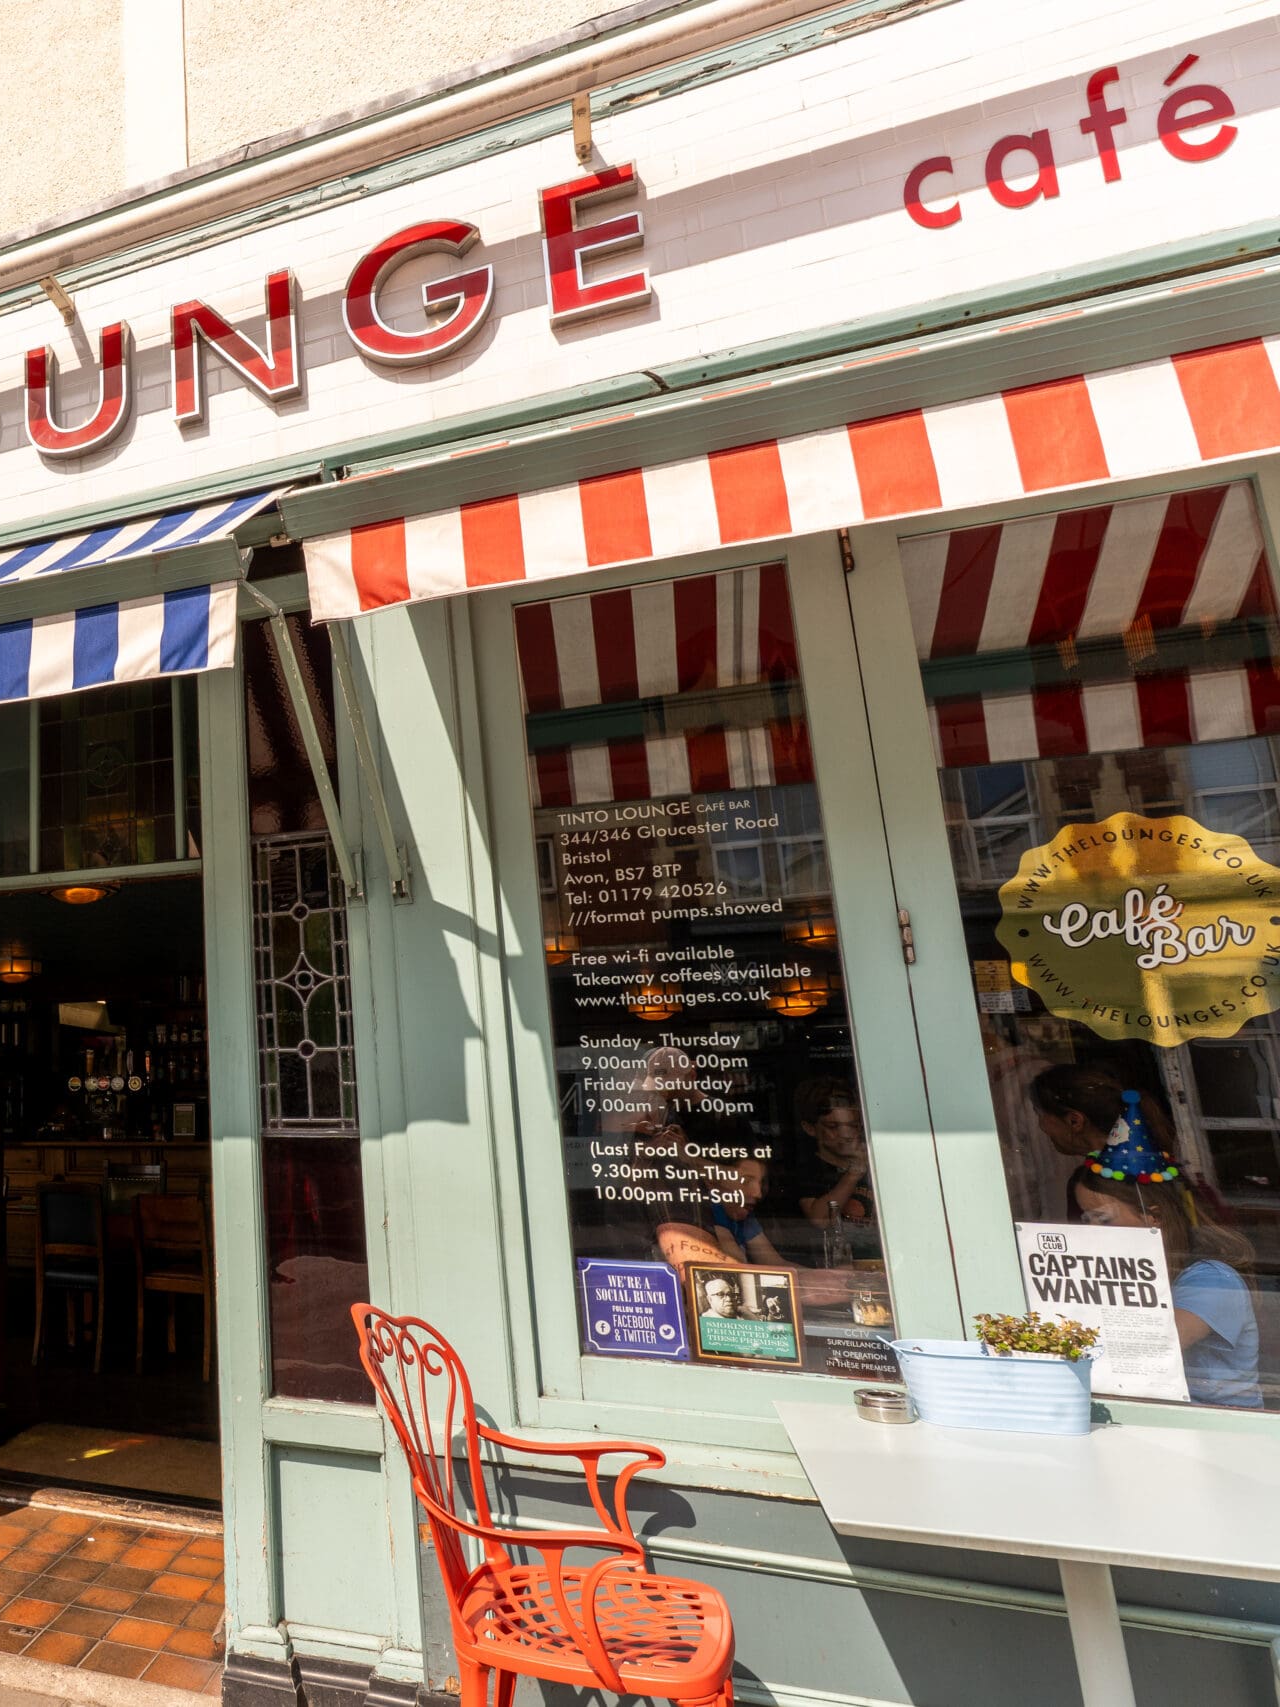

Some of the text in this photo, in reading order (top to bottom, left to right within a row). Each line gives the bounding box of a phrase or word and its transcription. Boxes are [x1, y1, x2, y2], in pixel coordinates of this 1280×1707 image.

[904, 54, 1238, 229] café
[557, 810, 609, 826] TINTO
[615, 802, 691, 821] LOUNGE
[729, 800, 751, 811] BAR
[560, 814, 779, 846] 344/346 Gloucester Road
[562, 850, 611, 866] Bristol
[564, 864, 682, 886] Avon, BS7 8TP
[565, 881, 728, 906] Tel: 01179 420526
[651, 898, 783, 925] pumps.showed
[1042, 884, 1184, 948] Café
[1136, 916, 1255, 970] Bar
[571, 944, 735, 966] Free wi-fi available
[572, 969, 655, 988] Takeaway
[660, 968, 722, 984] coffees
[728, 963, 812, 980] available
[575, 986, 771, 1008] www.thelounges.co.uk
[579, 1033, 642, 1051] Sunday
[659, 1032, 741, 1050] Thursday
[581, 1055, 647, 1070] 9.00am
[668, 1054, 748, 1072] 10.00pm
[584, 1076, 635, 1094] Friday
[654, 1076, 733, 1094] Saturday
[586, 1098, 652, 1113] 9.00am
[673, 1098, 754, 1115] 11.00pm
[590, 1141, 772, 1159] (Last Food Orders at
[591, 1163, 746, 1184] 9.30pm Sun-Thu,
[595, 1185, 746, 1208] 10.00pm Fri-Sat)
[1041, 1234, 1061, 1243] TALK
[1042, 1242, 1063, 1250] CLUB
[1028, 1253, 1157, 1282] CAPTAINS
[608, 1275, 651, 1290] WE'RE A
[595, 1288, 667, 1305] SOCIAL BUNCH
[1031, 1277, 1168, 1309] WANTED.
[612, 1305, 634, 1313] FOLLOW
[613, 1314, 656, 1330] FACEBOOK
[706, 1321, 752, 1331] SMOKING
[754, 1324, 764, 1332] IS
[614, 1329, 621, 1342] &
[622, 1329, 657, 1344] TWITTER
[707, 1327, 769, 1339] PERMITTED
[707, 1334, 739, 1343] THESE
[844, 1329, 870, 1338] CCTV
[827, 1338, 881, 1350] SURVEILLANCE
[842, 1350, 888, 1361] OPERATION
[837, 1360, 860, 1370] THESE
[861, 1363, 897, 1373] PREMISES
